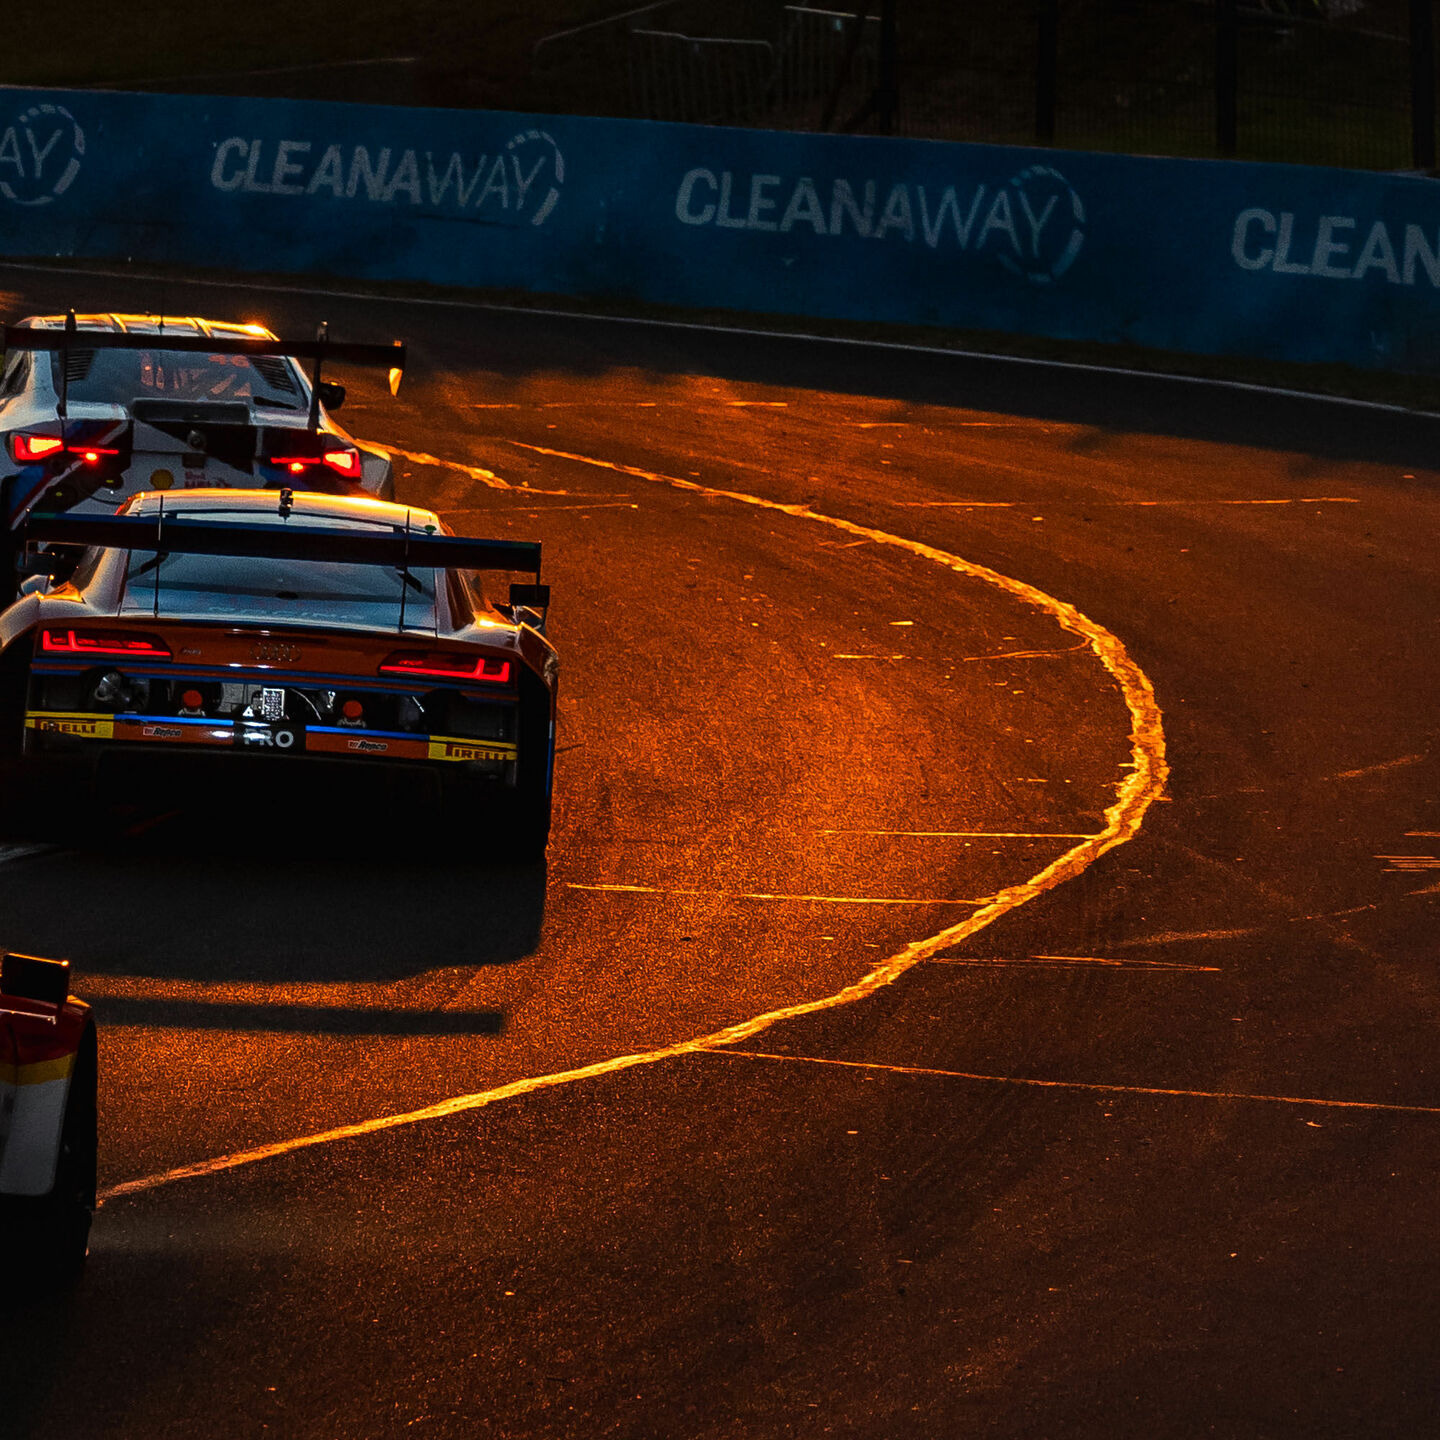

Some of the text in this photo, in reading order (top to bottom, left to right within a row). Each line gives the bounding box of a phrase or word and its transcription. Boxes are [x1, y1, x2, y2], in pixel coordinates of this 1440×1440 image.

[210, 136, 546, 211] CLEANAWAY
[676, 167, 1058, 257] CLEANAWAY
[1231, 208, 1440, 289] CLEAN
[244, 728, 294, 748] PRO
